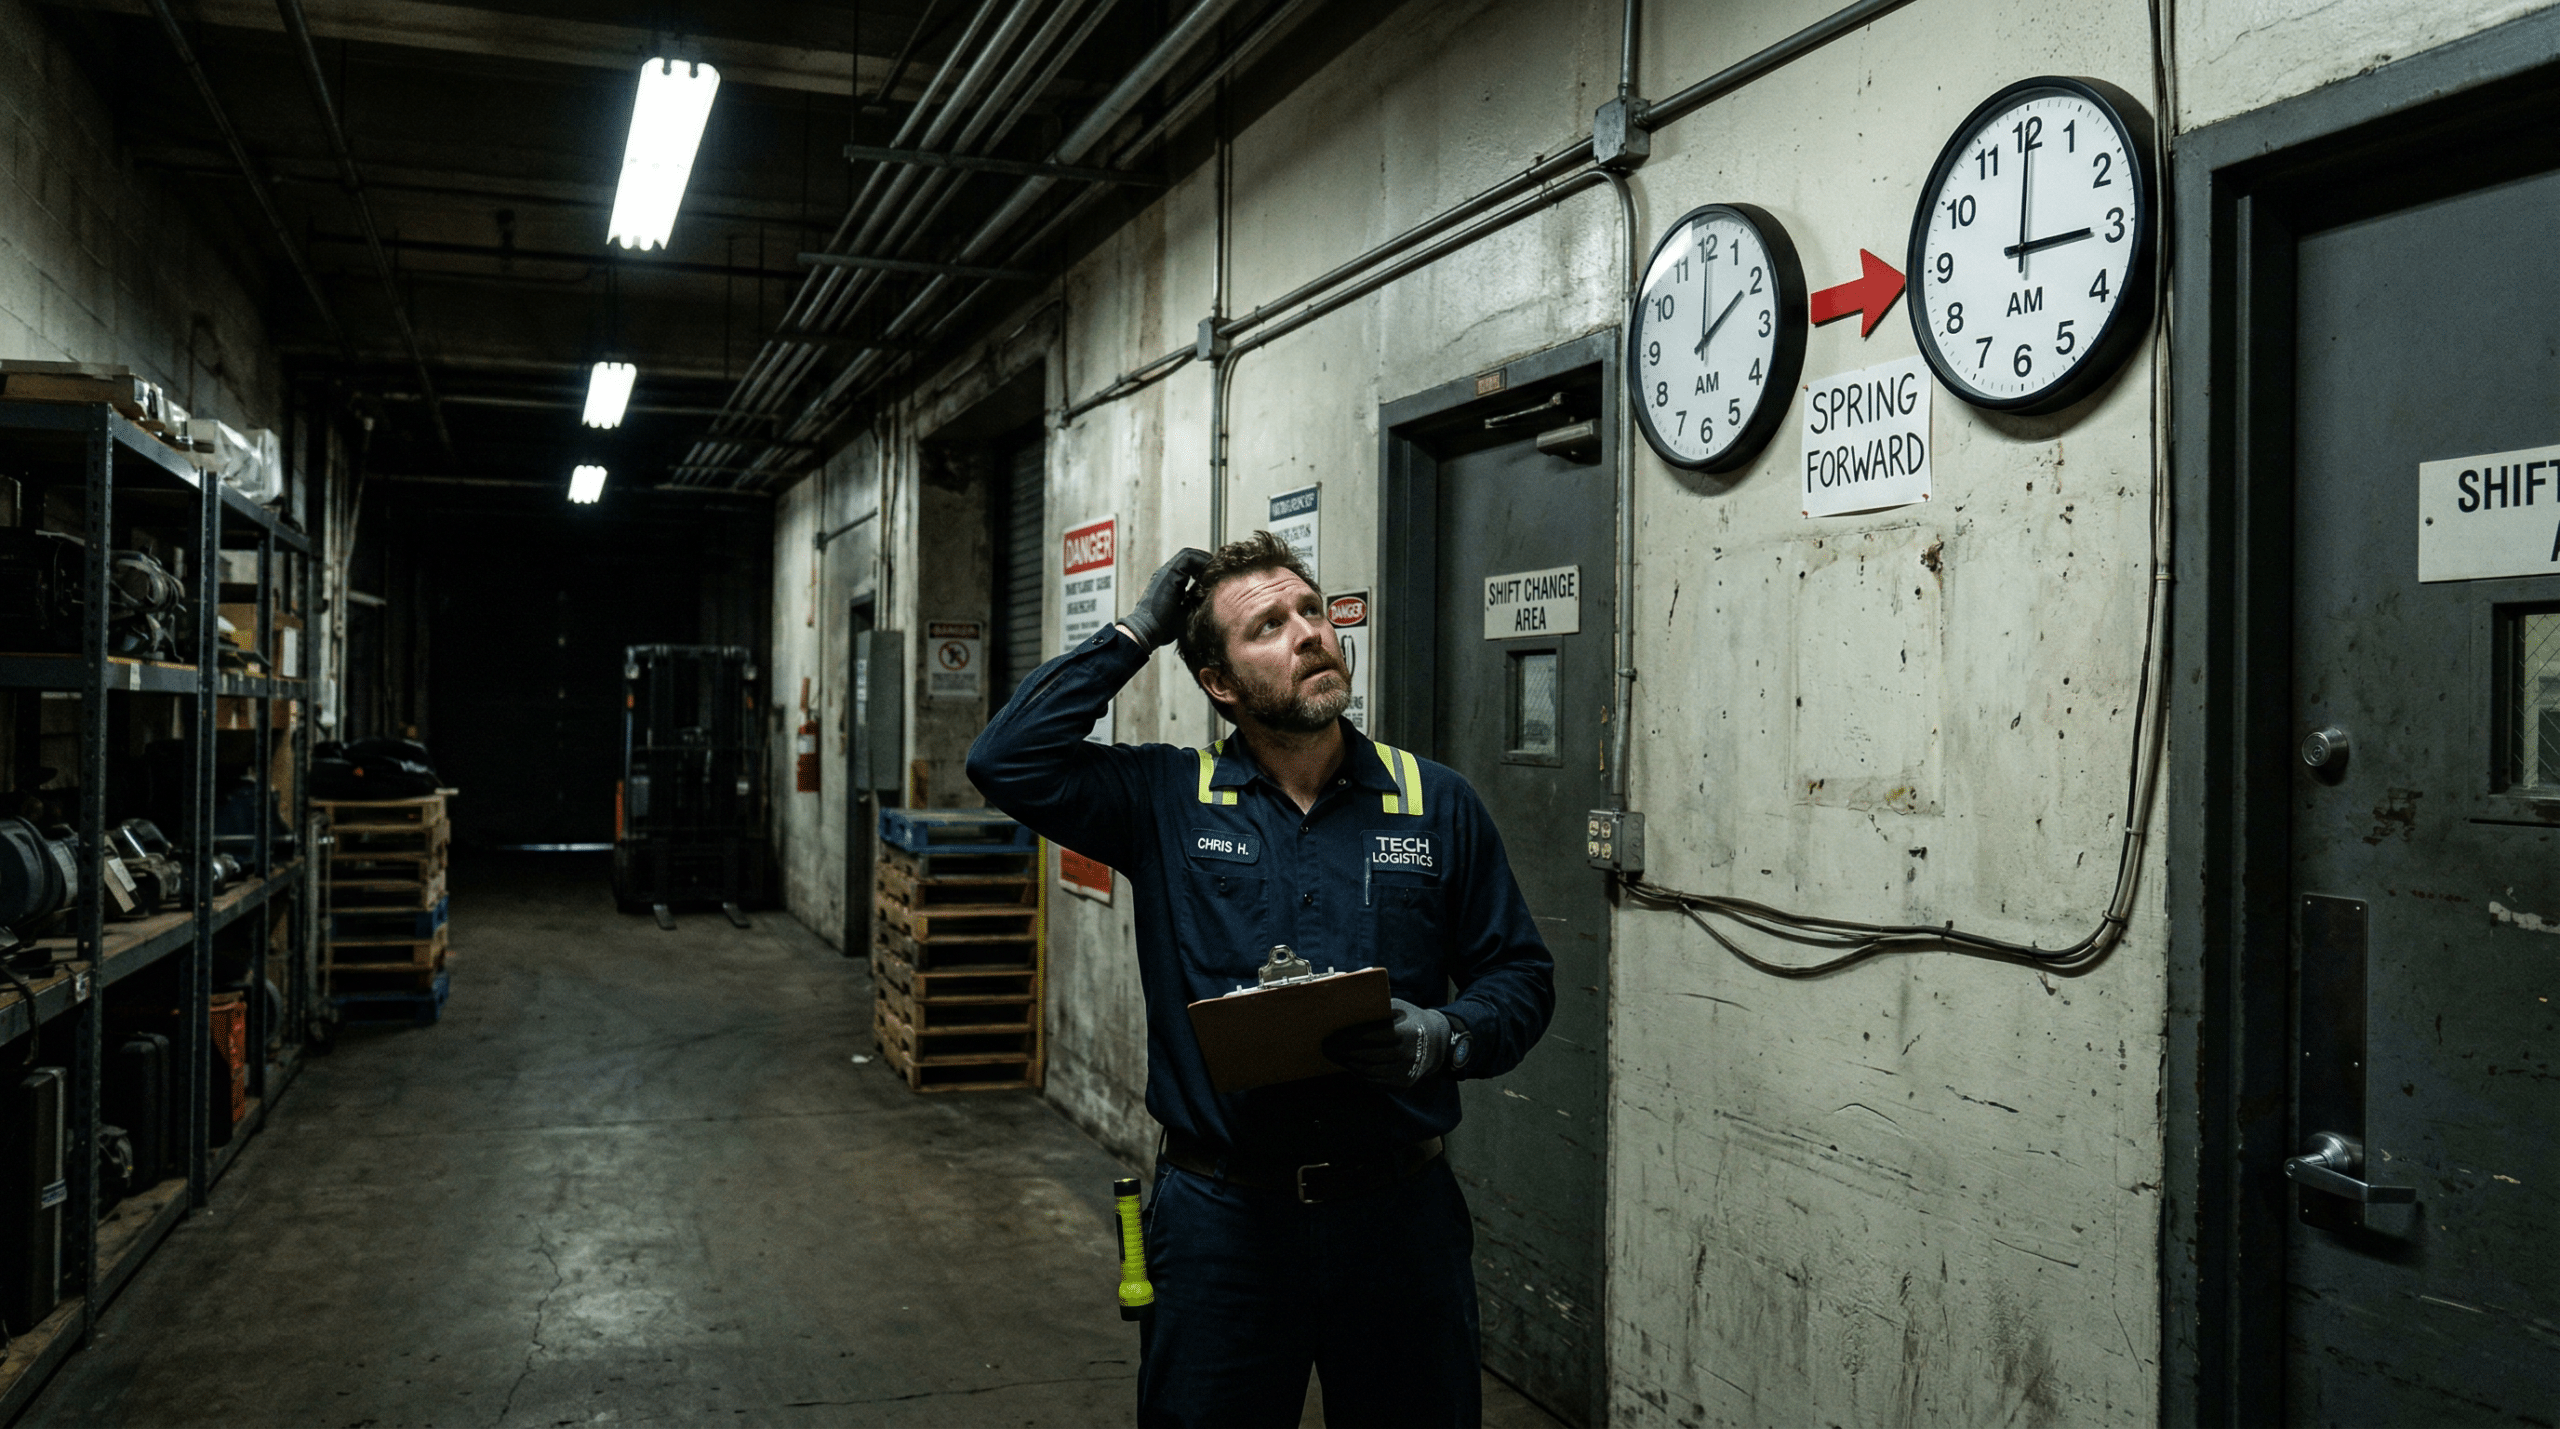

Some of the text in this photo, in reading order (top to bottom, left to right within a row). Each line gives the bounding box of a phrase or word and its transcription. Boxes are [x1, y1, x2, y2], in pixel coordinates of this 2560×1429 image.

[2012, 116, 2043, 154] 12
[2062, 119, 2075, 153] 1
[1975, 143, 1999, 180] 11
[2092, 152, 2112, 189] 2
[1946, 194, 1976, 230] 10
[2104, 206, 2125, 243] 3
[1697, 234, 1718, 263] 12
[1730, 239, 1739, 265] 1
[1674, 256, 1689, 284] 11
[1749, 266, 1762, 295] 2
[1936, 252, 1954, 284] 9
[2088, 268, 2110, 303] 4
[1655, 294, 1675, 322] 10
[2006, 286, 2043, 318] AM
[1758, 309, 1771, 338] 3
[1946, 302, 1964, 334] 8
[2055, 320, 2075, 355] 5
[1649, 341, 1661, 366] 9
[1975, 336, 1993, 369] 7
[2013, 344, 2032, 377] 6
[1694, 371, 1719, 396] AM
[1748, 357, 1762, 385] 4
[1656, 381, 1668, 407] 8
[1810, 372, 1918, 434] SPRING
[1675, 410, 1687, 436] 7
[1728, 398, 1741, 426] 5
[1701, 417, 1713, 443] 6
[1807, 432, 1925, 493] FORWARD
[1066, 529, 1112, 569] DANGER
[1488, 573, 1575, 606] SHIFT CHANGE
[1331, 602, 1363, 620] DANGER
[1515, 606, 1547, 632] AREA
[1197, 837, 1249, 856] CHRIS H.
[1372, 852, 1433, 867] LOGISTICS
[1375, 836, 1429, 854] TECH
